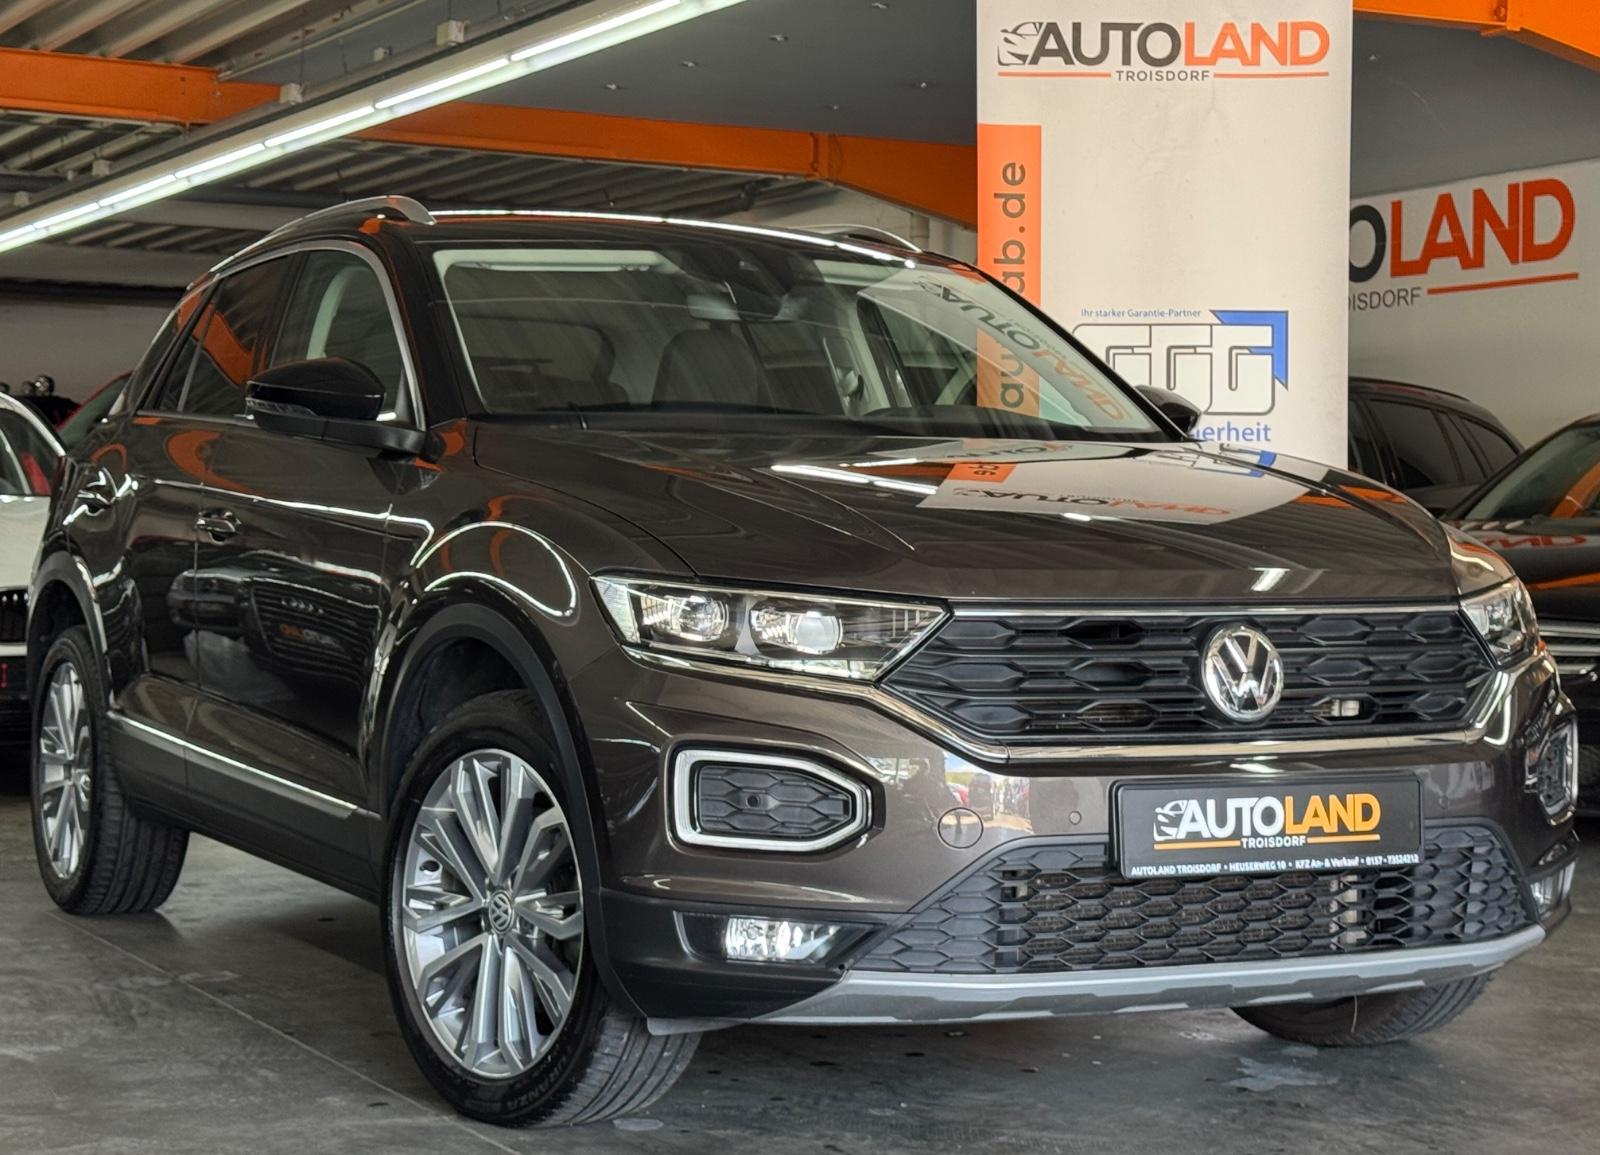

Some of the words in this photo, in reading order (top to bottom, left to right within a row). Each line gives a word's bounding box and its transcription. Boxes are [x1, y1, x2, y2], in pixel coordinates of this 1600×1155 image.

[1028, 21, 1330, 67] AUTOLAND
[1115, 70, 1211, 82] TROISDORF
[1348, 286, 1422, 311] ISDORF
[1081, 308, 1093, 318] Ihr
[1095, 308, 1125, 318] starker
[1127, 308, 1201, 318] Garantie-Partner
[1176, 793, 1382, 839] AUTOLAND
[1241, 835, 1307, 849] TROISDORF
[1131, 864, 1176, 876] AUTOLAND
[1176, 862, 1222, 874] TROISDORF
[1229, 860, 1276, 872] HEUSERWEG
